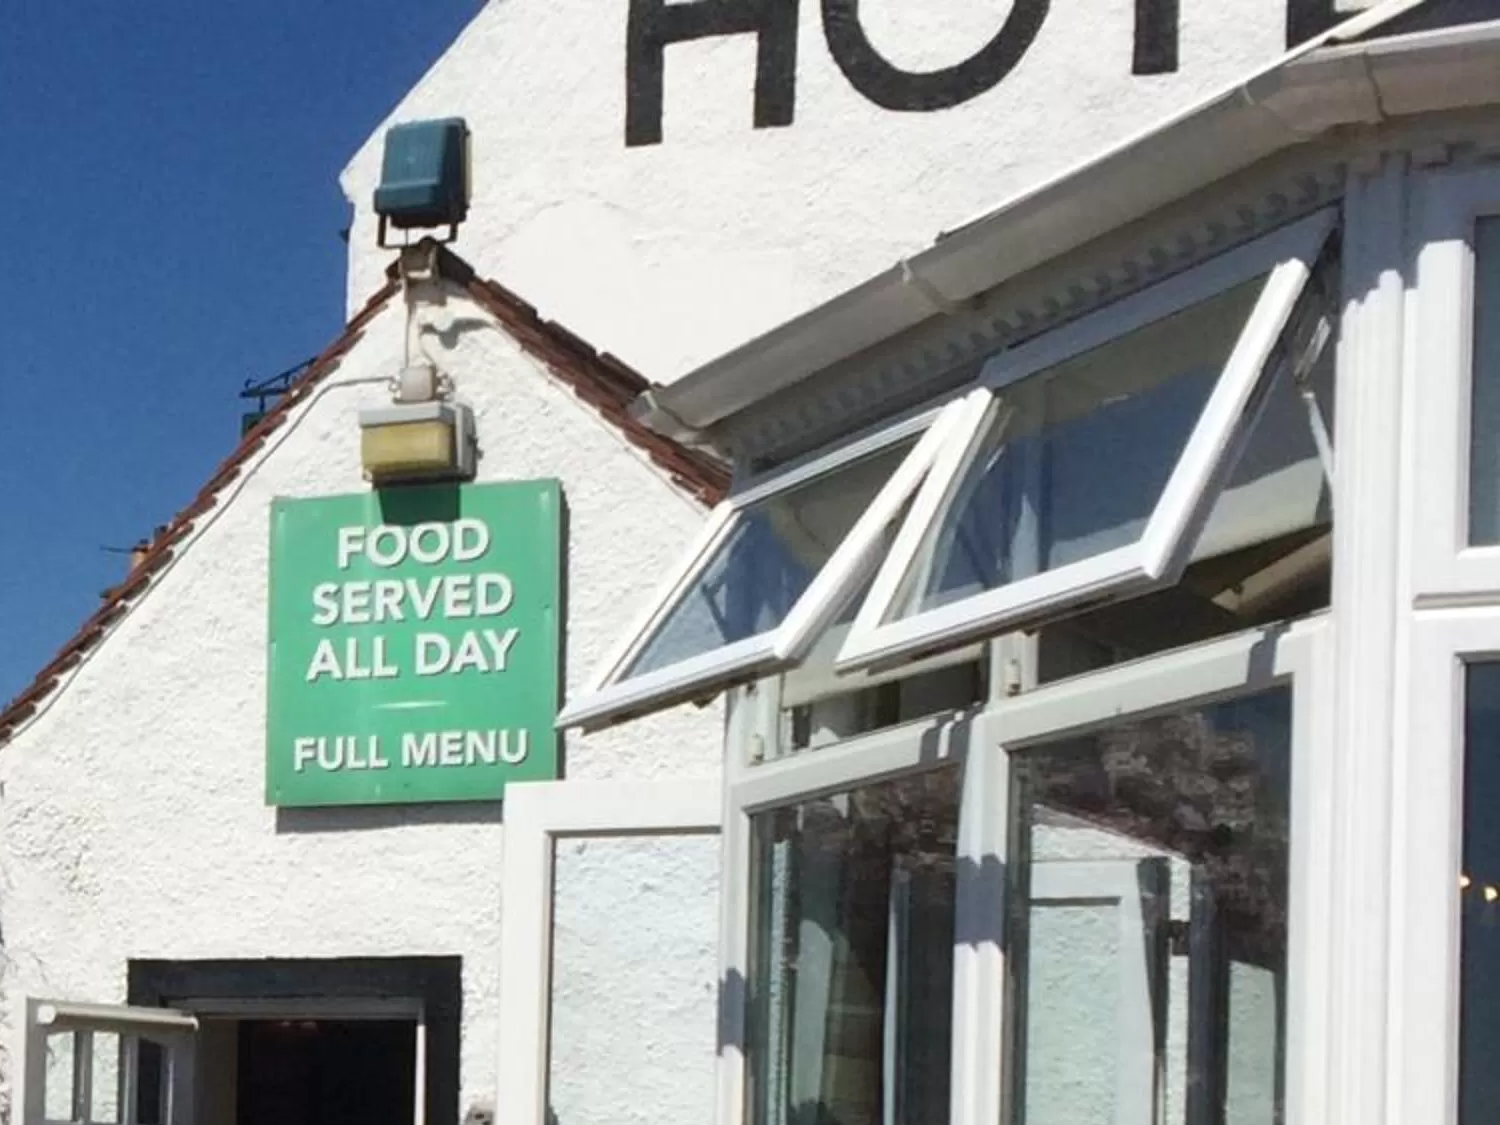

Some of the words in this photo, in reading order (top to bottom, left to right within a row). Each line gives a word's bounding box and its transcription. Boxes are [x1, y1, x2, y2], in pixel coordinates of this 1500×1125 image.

[624, 0, 1370, 147] HO
[338, 518, 491, 569] FOOD
[311, 573, 514, 626] SERVED
[306, 635, 399, 682] ALL
[415, 628, 520, 676] DAY
[293, 734, 390, 772] FULL
[402, 728, 528, 767] MENU
